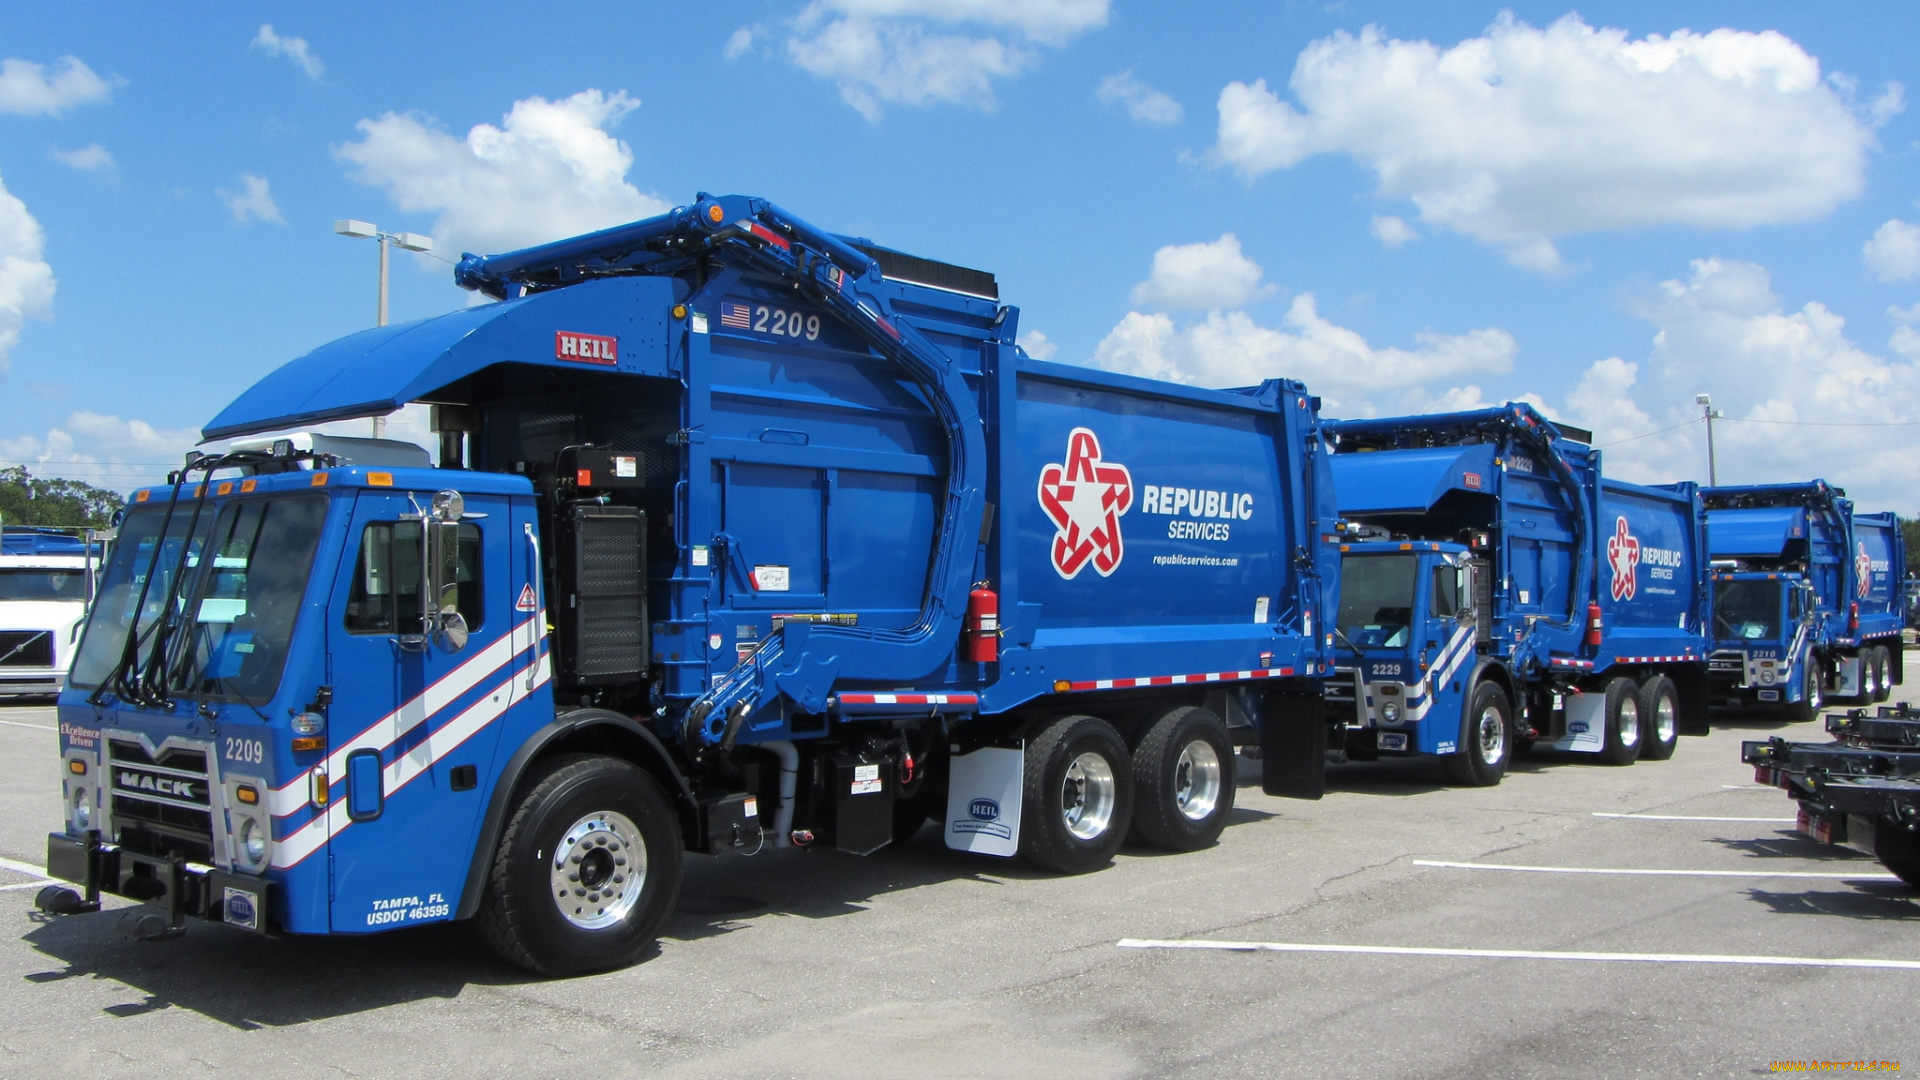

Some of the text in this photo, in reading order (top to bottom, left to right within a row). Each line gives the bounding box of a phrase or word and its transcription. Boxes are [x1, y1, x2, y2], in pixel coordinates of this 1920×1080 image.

[754, 306, 820, 341] 2209
[561, 336, 614, 360] HEIL
[1142, 485, 1253, 520] REPUBLIC
[1168, 520, 1230, 541] SERVICES
[1152, 554, 1238, 567] republicservices.com
[1642, 547, 1681, 568] REPUBLIC
[1372, 664, 1401, 675] 2229
[69, 735, 94, 747] Driven
[226, 737, 262, 764] 2209
[121, 772, 195, 798] MACK
[972, 805, 997, 817] HEIL
[372, 893, 445, 911] TAMPA, FL
[366, 904, 449, 926] USDOT 463595
